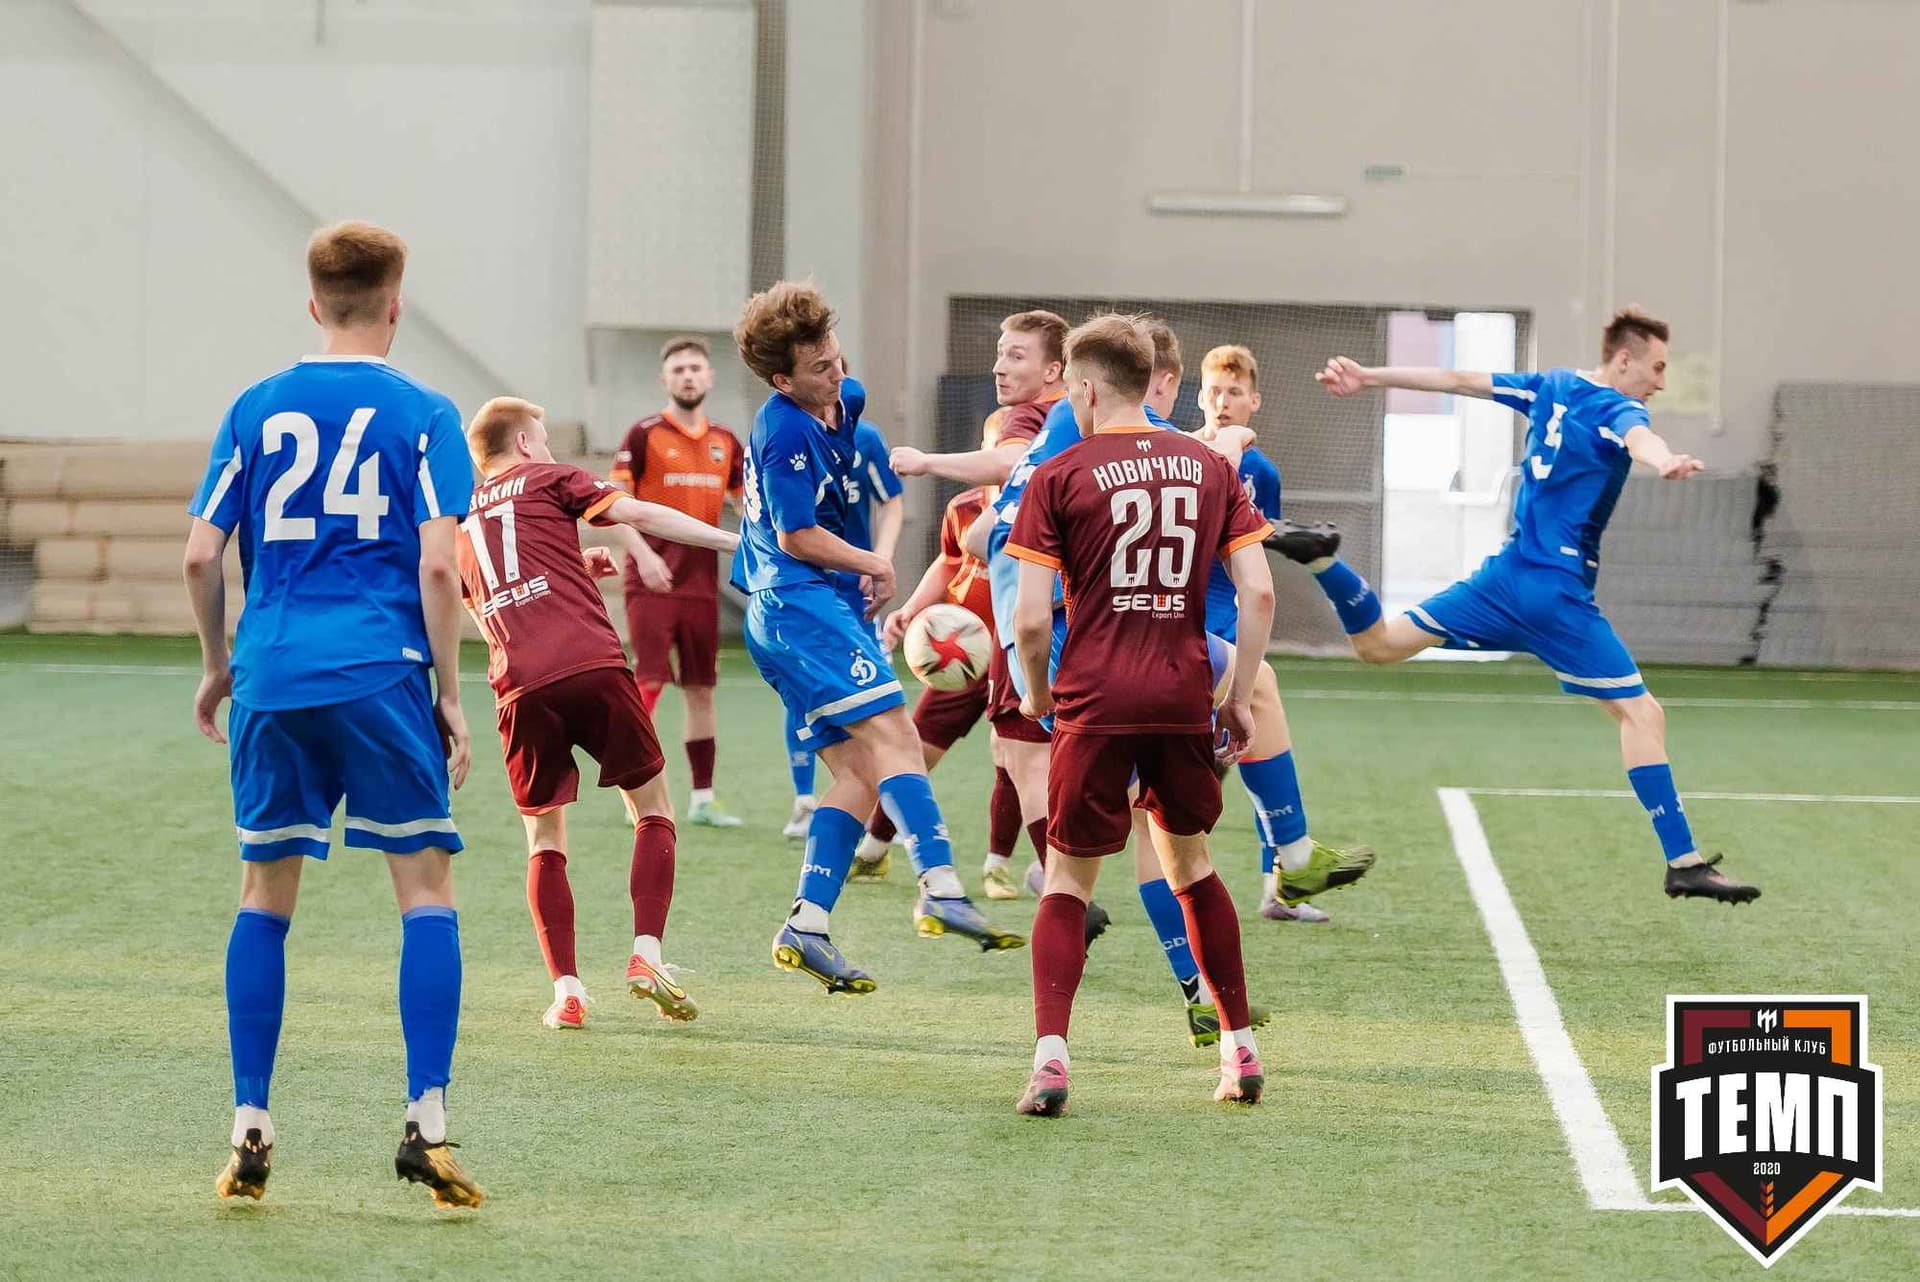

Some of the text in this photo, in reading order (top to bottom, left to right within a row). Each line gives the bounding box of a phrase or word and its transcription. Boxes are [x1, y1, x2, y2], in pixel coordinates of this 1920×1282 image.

[262, 407, 389, 542] 24
[1092, 455, 1203, 491] НОВИЧКОВ
[461, 499, 521, 590] 17
[1110, 486, 1198, 588] 25
[482, 575, 549, 619] SEUS
[1112, 593, 1186, 612] SEUS
